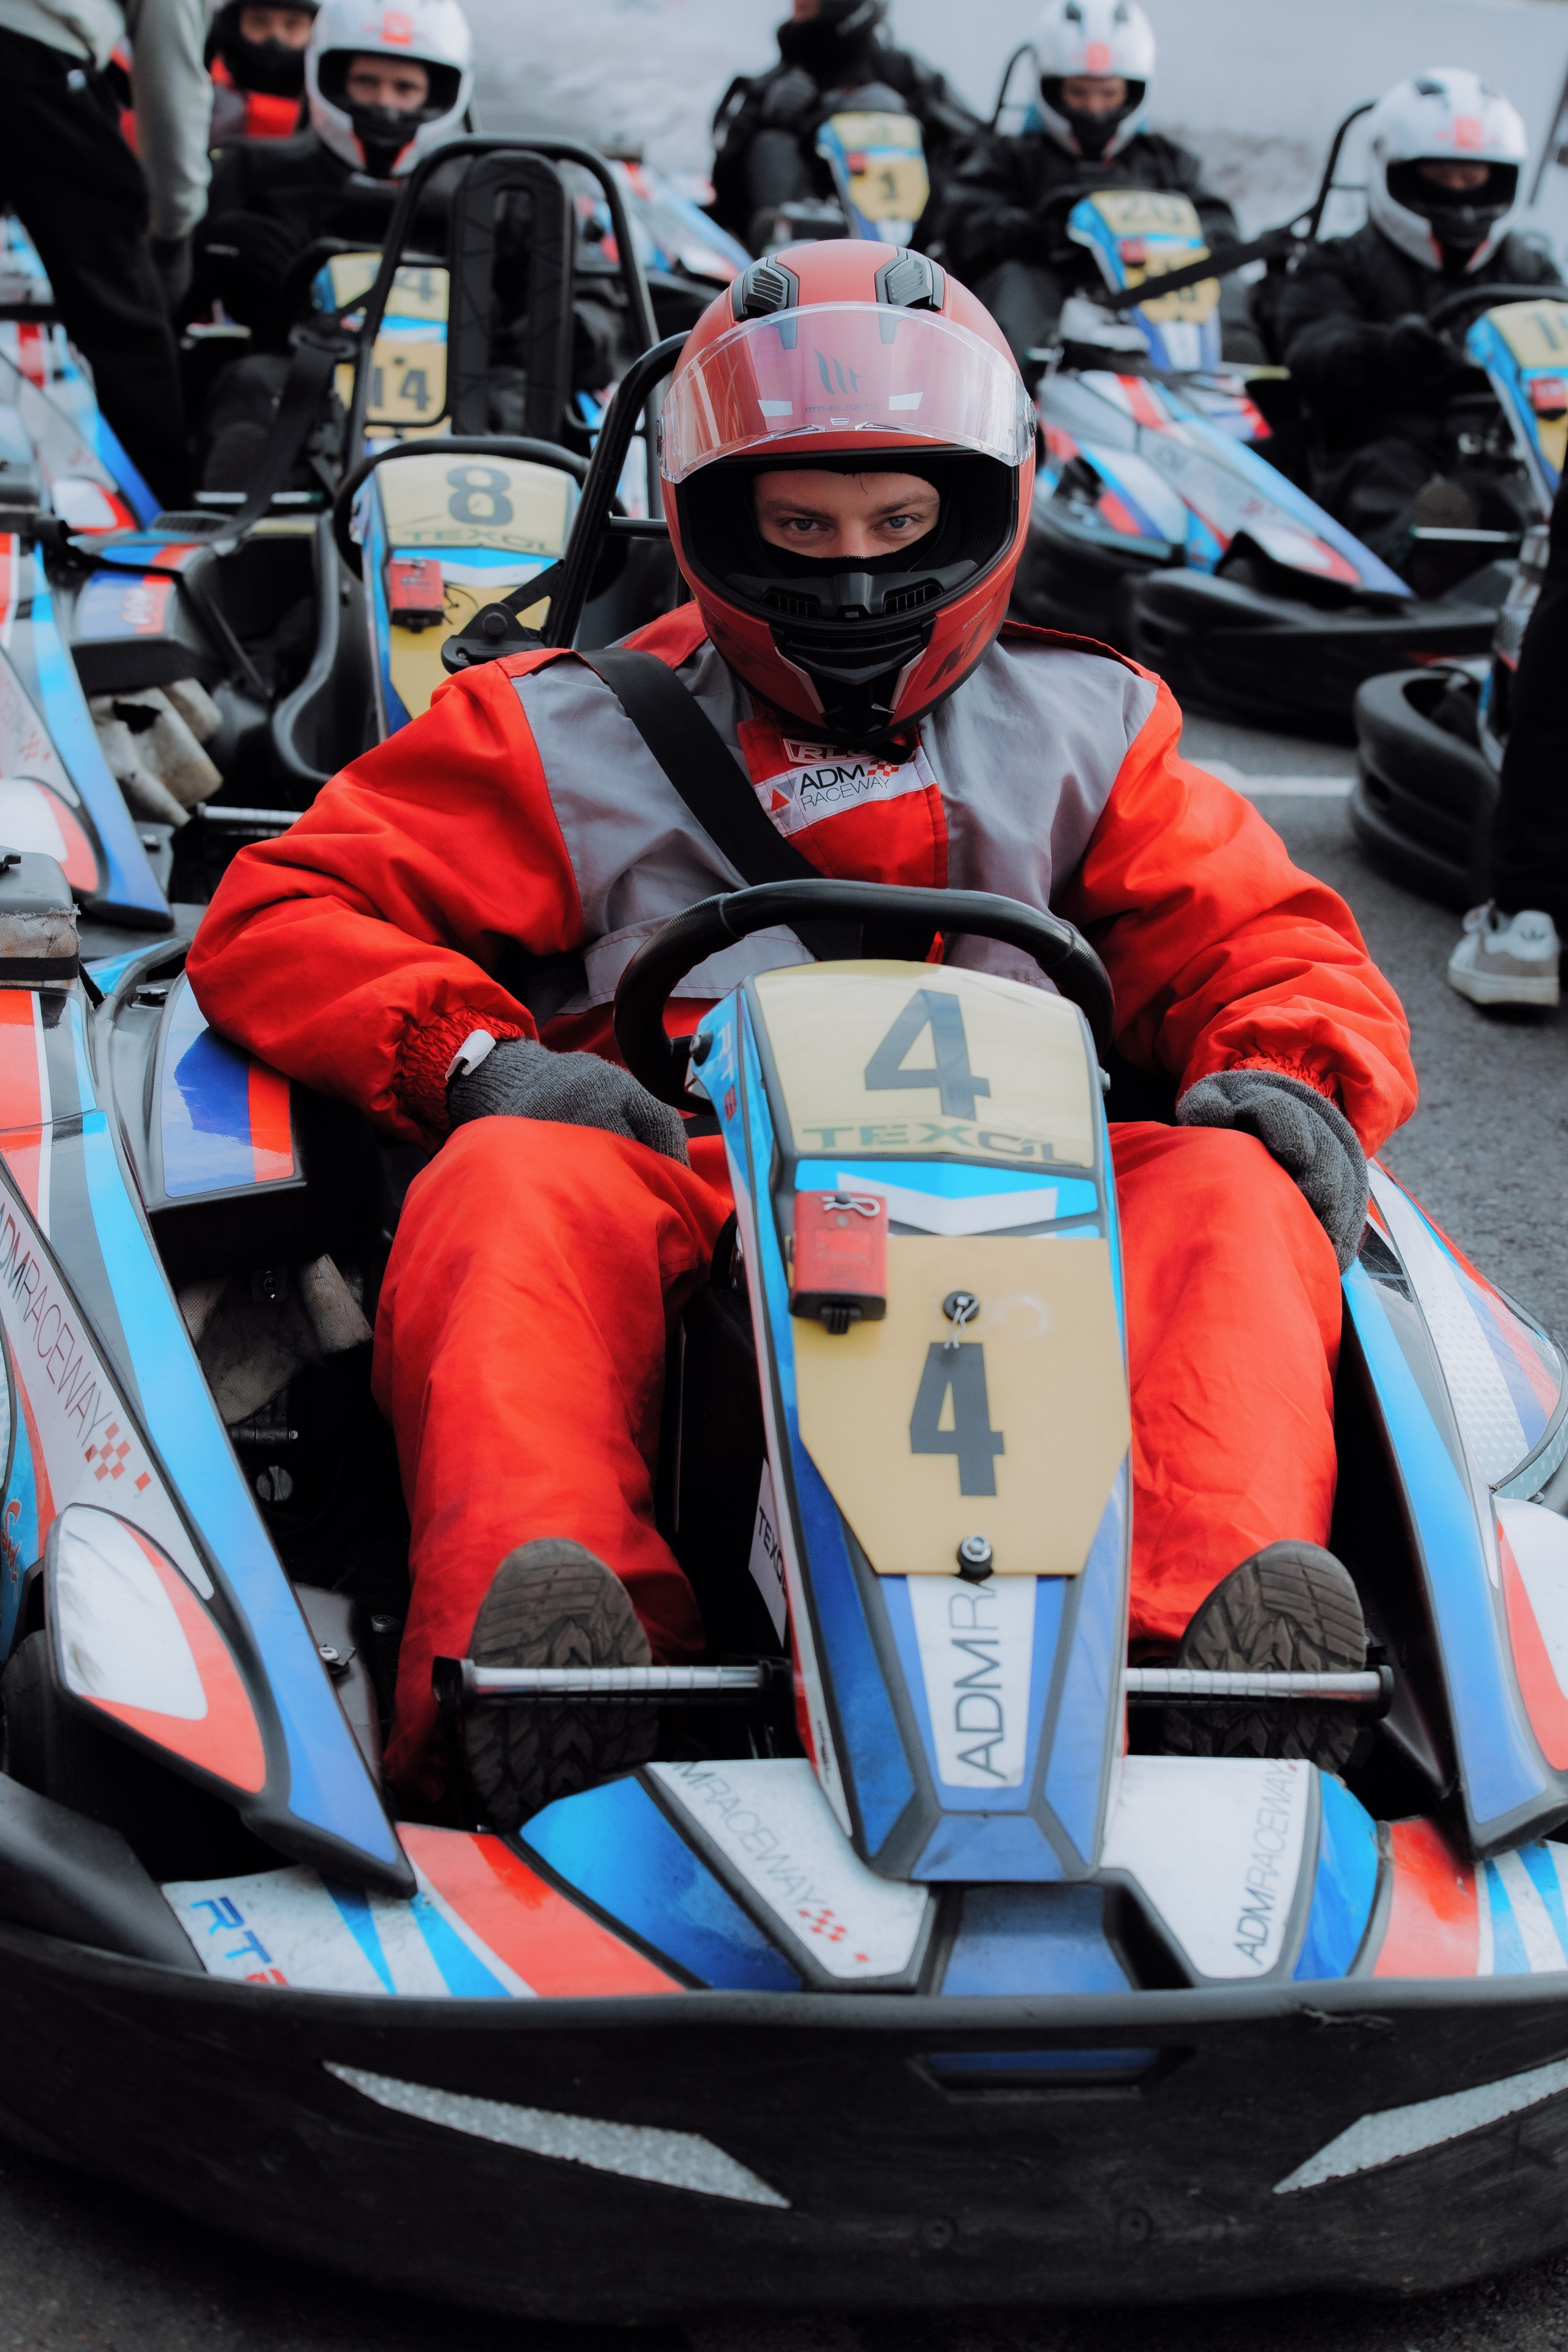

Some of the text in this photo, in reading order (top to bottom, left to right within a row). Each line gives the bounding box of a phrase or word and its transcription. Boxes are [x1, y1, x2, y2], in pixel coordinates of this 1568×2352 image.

[446, 465, 513, 526] 8
[962, 598, 993, 630] STINGER
[800, 764, 865, 796] ADM
[801, 776, 890, 811] RACEWAY
[864, 989, 992, 1121] 4
[909, 1342, 1006, 1496] 4
[1234, 1758, 1296, 1966] ADMRACEWAY
